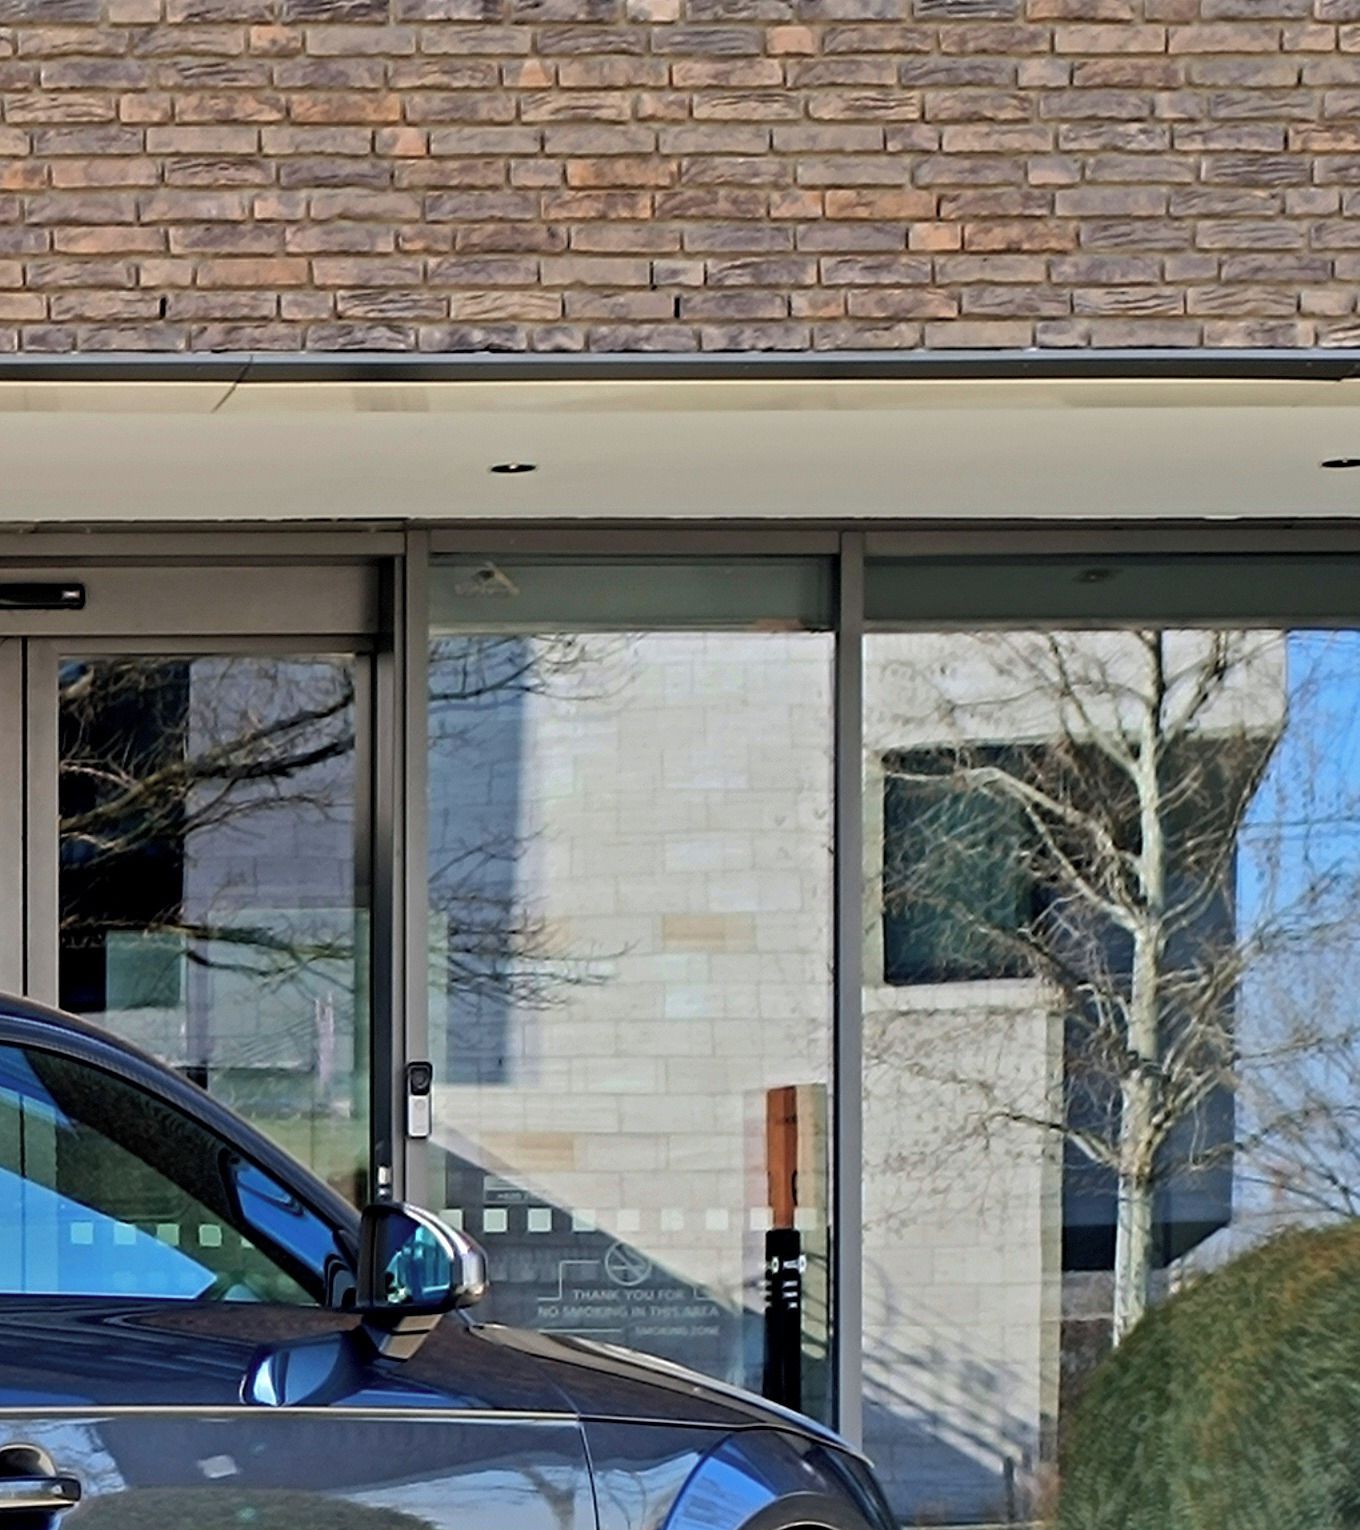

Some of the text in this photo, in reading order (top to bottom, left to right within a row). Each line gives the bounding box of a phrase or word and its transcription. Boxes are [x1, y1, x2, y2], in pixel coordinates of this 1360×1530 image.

[573, 1289, 684, 1301] THANK YOU FOR
[538, 1306, 720, 1317] NO SMOKING IN THIS AREA
